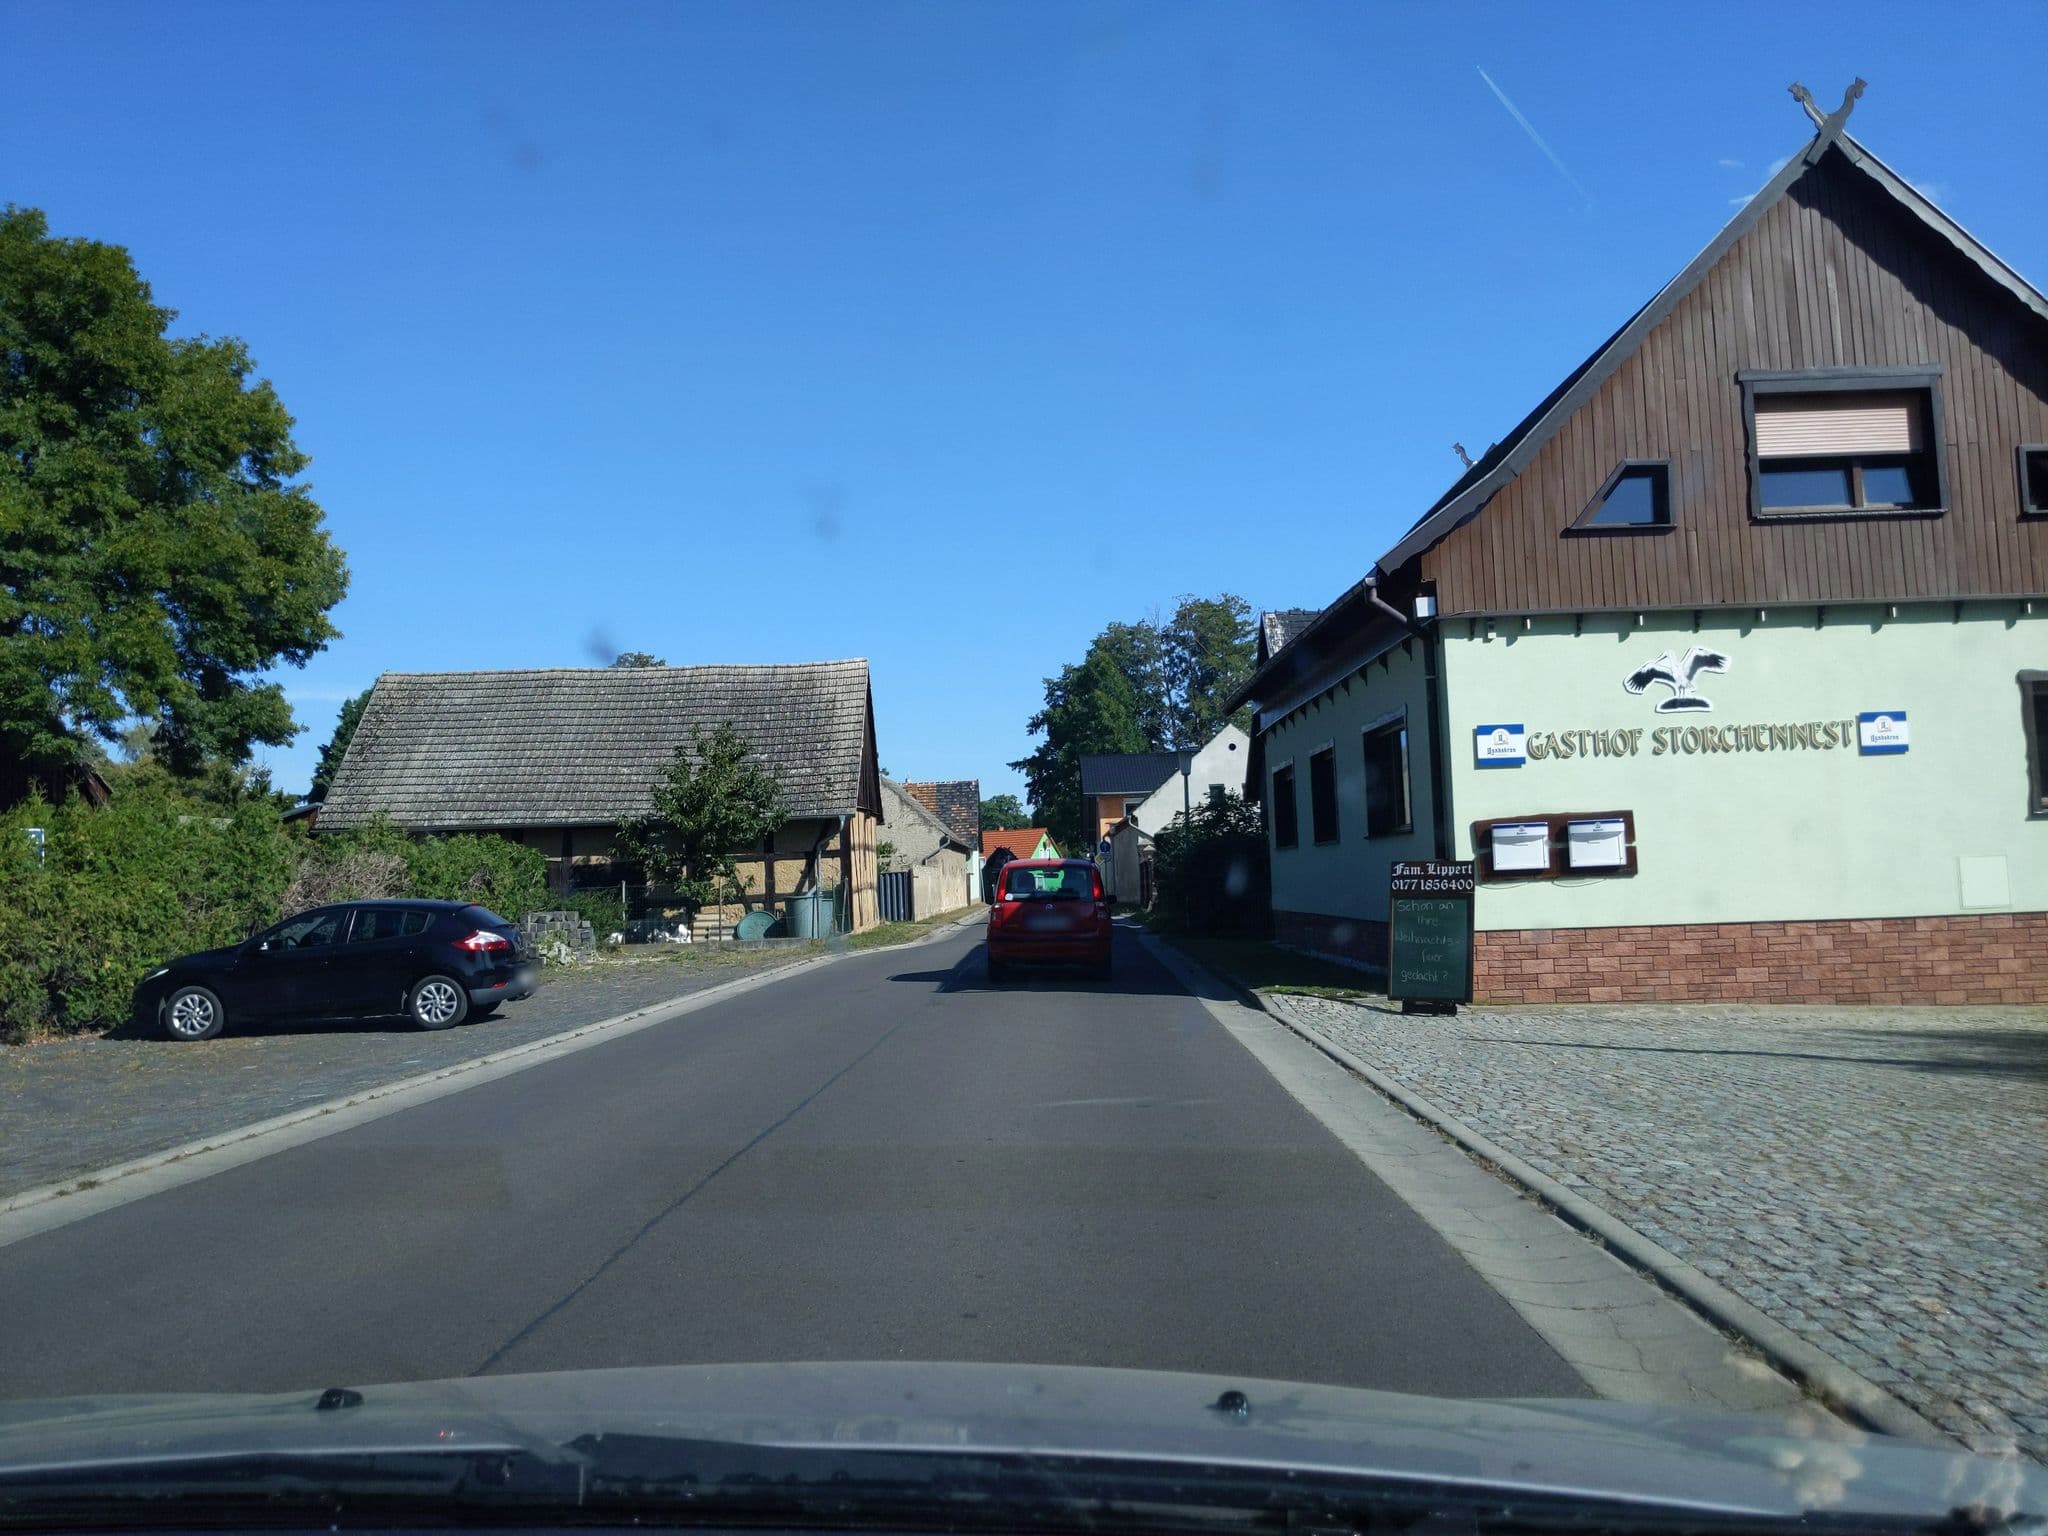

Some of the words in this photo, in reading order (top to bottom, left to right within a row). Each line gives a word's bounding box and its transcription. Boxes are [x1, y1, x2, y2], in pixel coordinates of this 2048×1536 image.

[1527, 728, 1644, 761] GASTHOF
[1652, 719, 1855, 757] STORCHENNEST
[1392, 863, 1424, 876] Fam.
[1426, 863, 1472, 877] Lippert
[1391, 879, 1418, 890] 0177
[1421, 879, 1474, 891] 1856400
